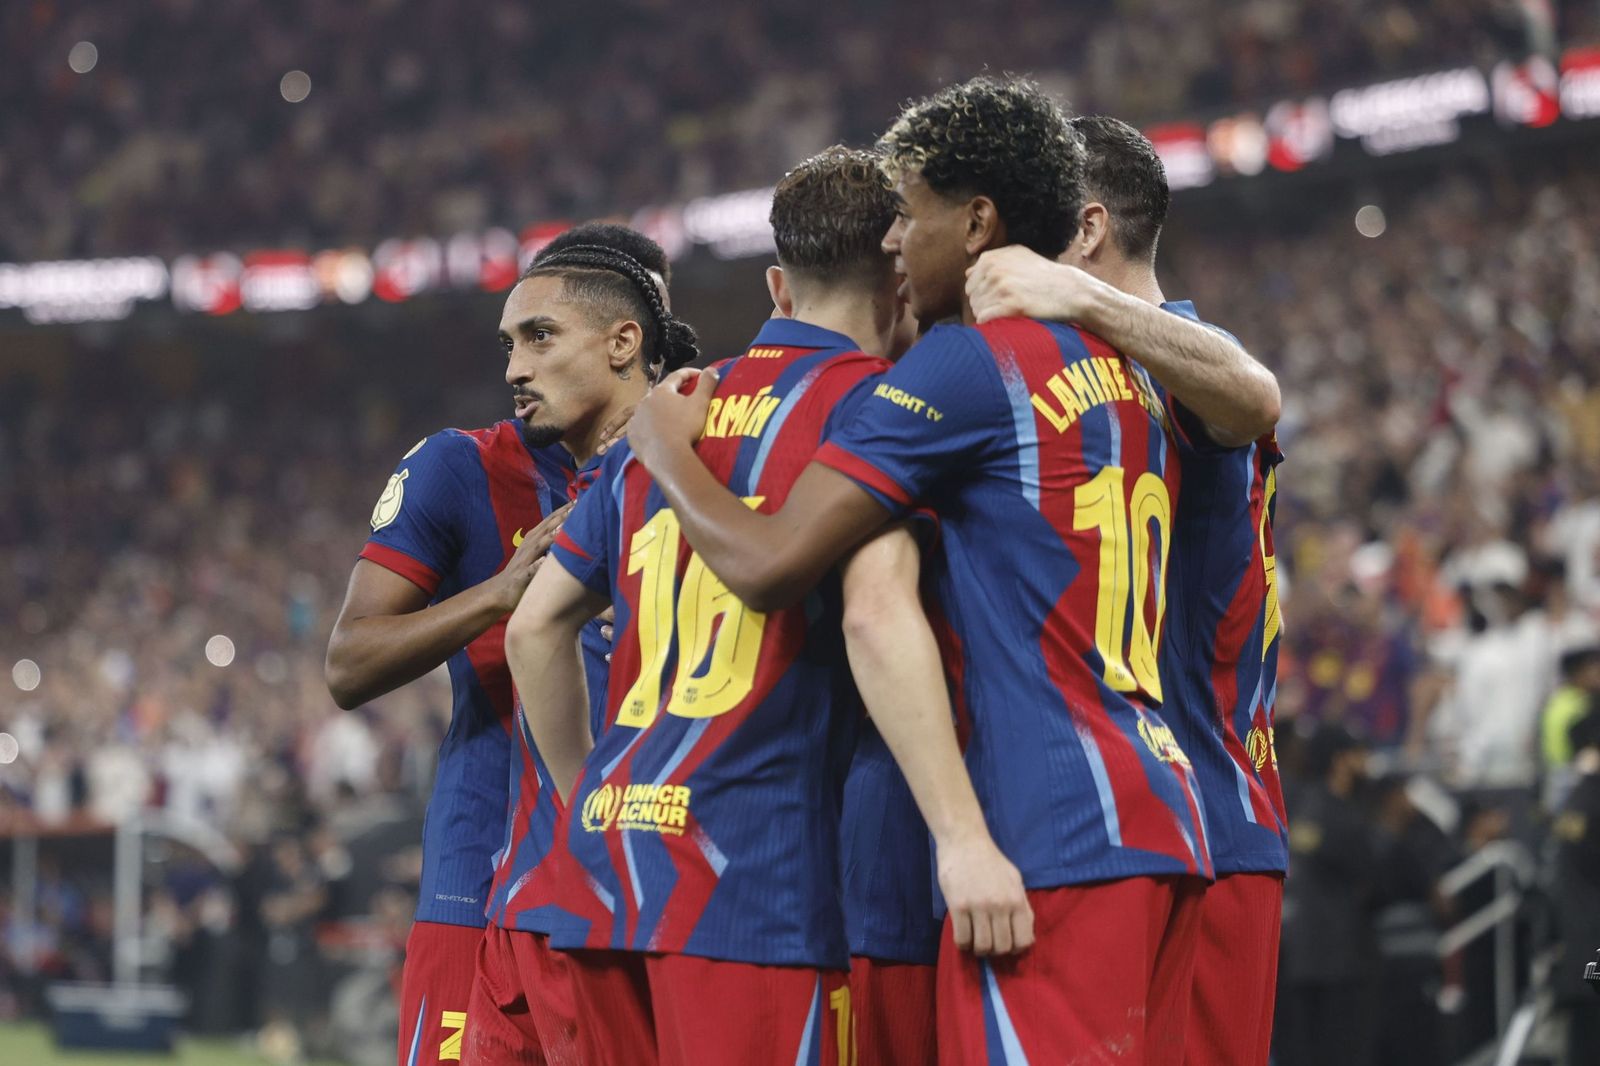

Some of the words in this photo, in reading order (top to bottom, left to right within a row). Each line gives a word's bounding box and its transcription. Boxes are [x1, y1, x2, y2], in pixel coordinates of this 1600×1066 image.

[700, 385, 781, 440] RMÍN
[1030, 357, 1133, 434] LAMINE
[615, 496, 767, 728] 16
[1073, 465, 1171, 704] 10
[616, 803, 688, 827] ACNUR
[622, 784, 691, 807] UNHCR
